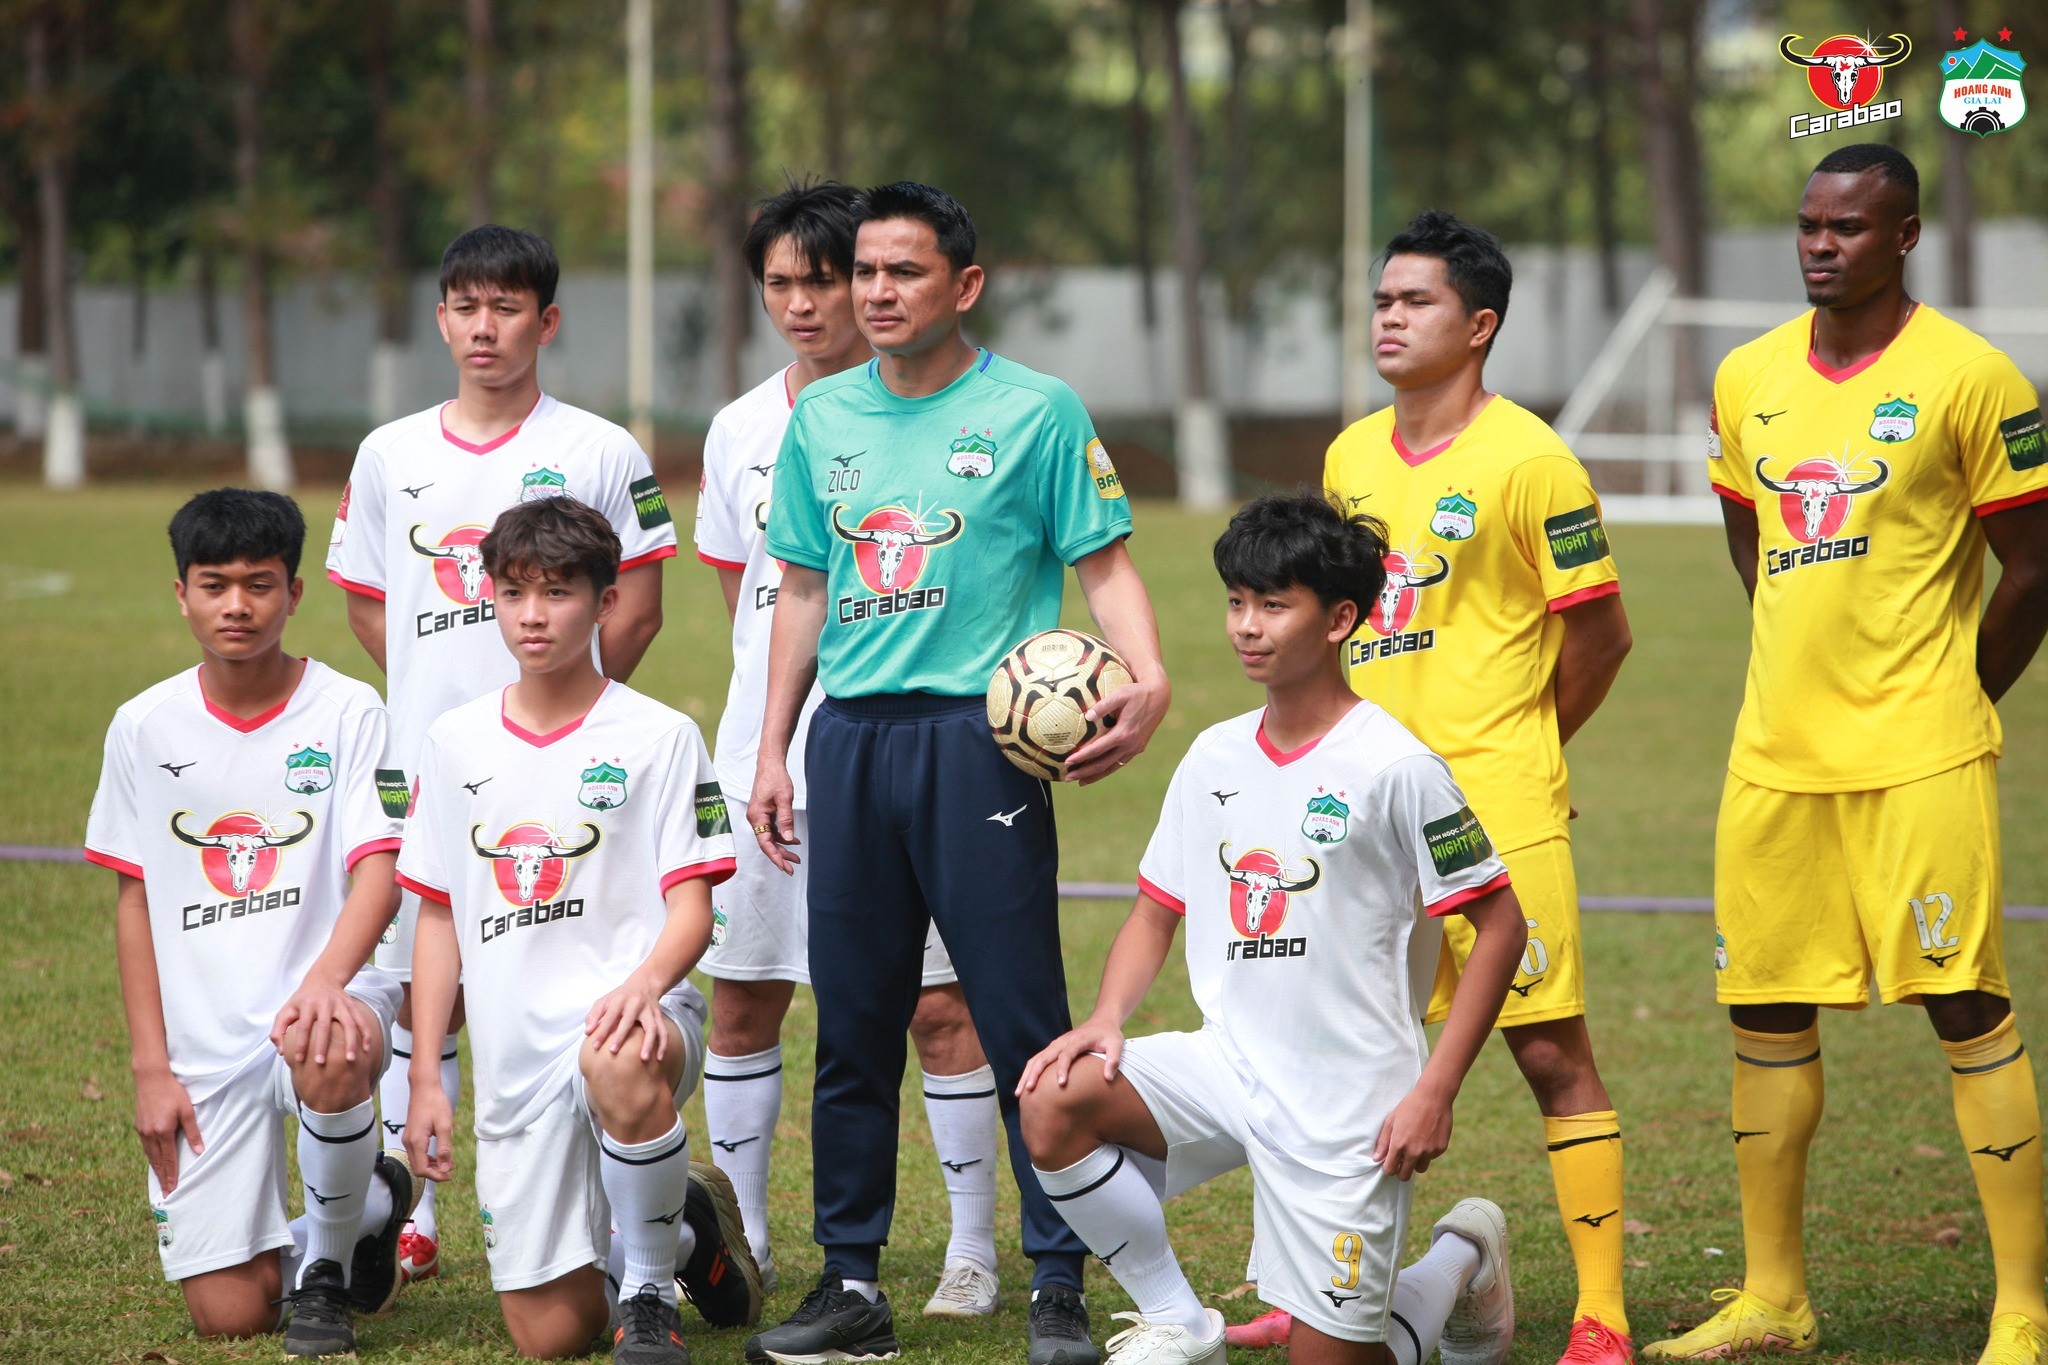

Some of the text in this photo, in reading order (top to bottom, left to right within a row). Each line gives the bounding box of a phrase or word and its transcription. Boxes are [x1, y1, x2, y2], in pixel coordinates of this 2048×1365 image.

[2008, 433, 2040, 456] NIGHT
[828, 469, 861, 493] ZICO
[636, 494, 665, 517] NIGHT
[1551, 531, 1588, 556] NIGHT
[1767, 535, 1870, 577] Carabao
[416, 599, 496, 638] Carab
[838, 586, 946, 626] Carabao
[1350, 628, 1436, 667] Carabao
[380, 790, 409, 806] NIGHT
[1431, 835, 1469, 862] NIGHT
[181, 886, 301, 931] Carabao
[479, 898, 585, 944] Carabao
[1908, 892, 1960, 950] 12
[1227, 933, 1308, 961] rabao
[1515, 918, 1549, 979] 6
[1331, 1232, 1364, 1290] 9
